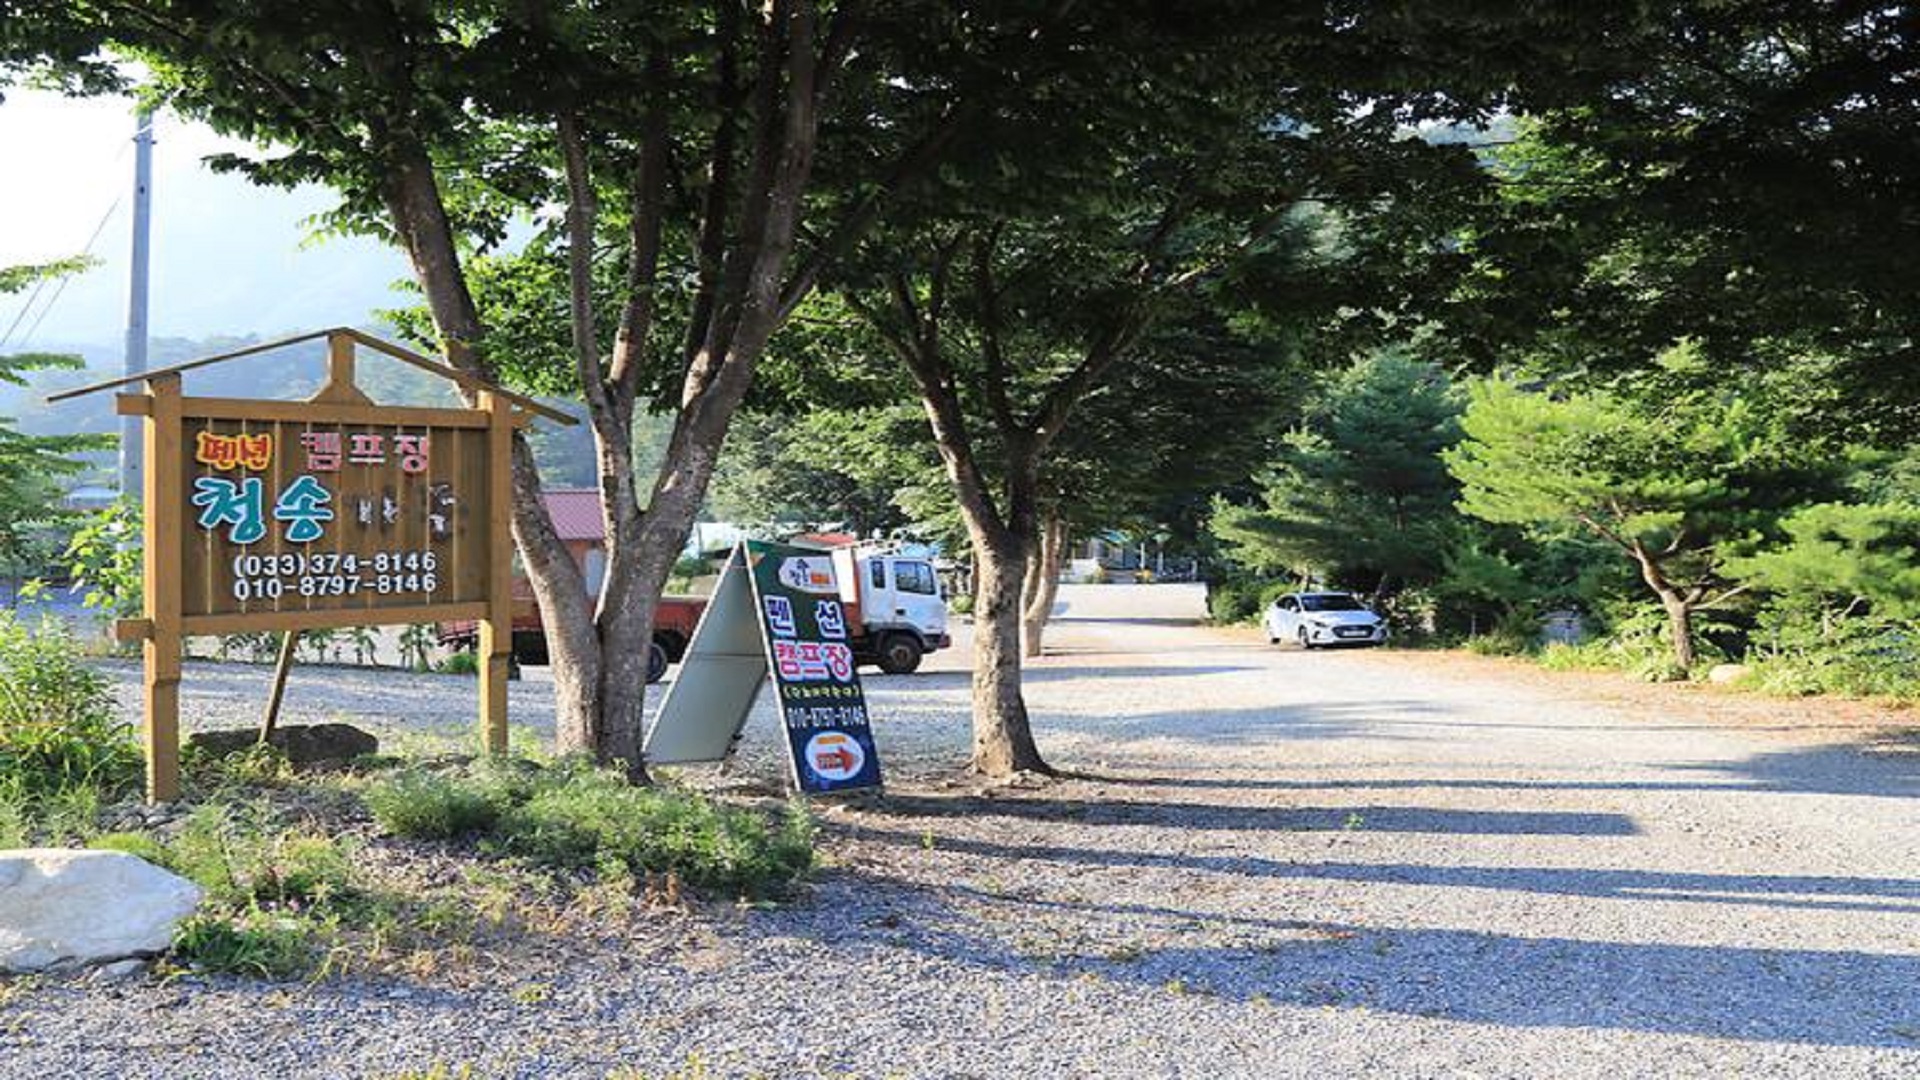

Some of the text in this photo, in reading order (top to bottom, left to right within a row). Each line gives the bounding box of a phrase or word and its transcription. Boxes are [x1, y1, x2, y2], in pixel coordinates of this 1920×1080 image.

[300, 432, 429, 472] 캠프장
[191, 475, 334, 543] 청송
[233, 552, 437, 577] (033)374-8146
[233, 573, 437, 600] 010-8797-8146
[763, 595, 846, 638] 펜션
[773, 639, 852, 682] 캠프장
